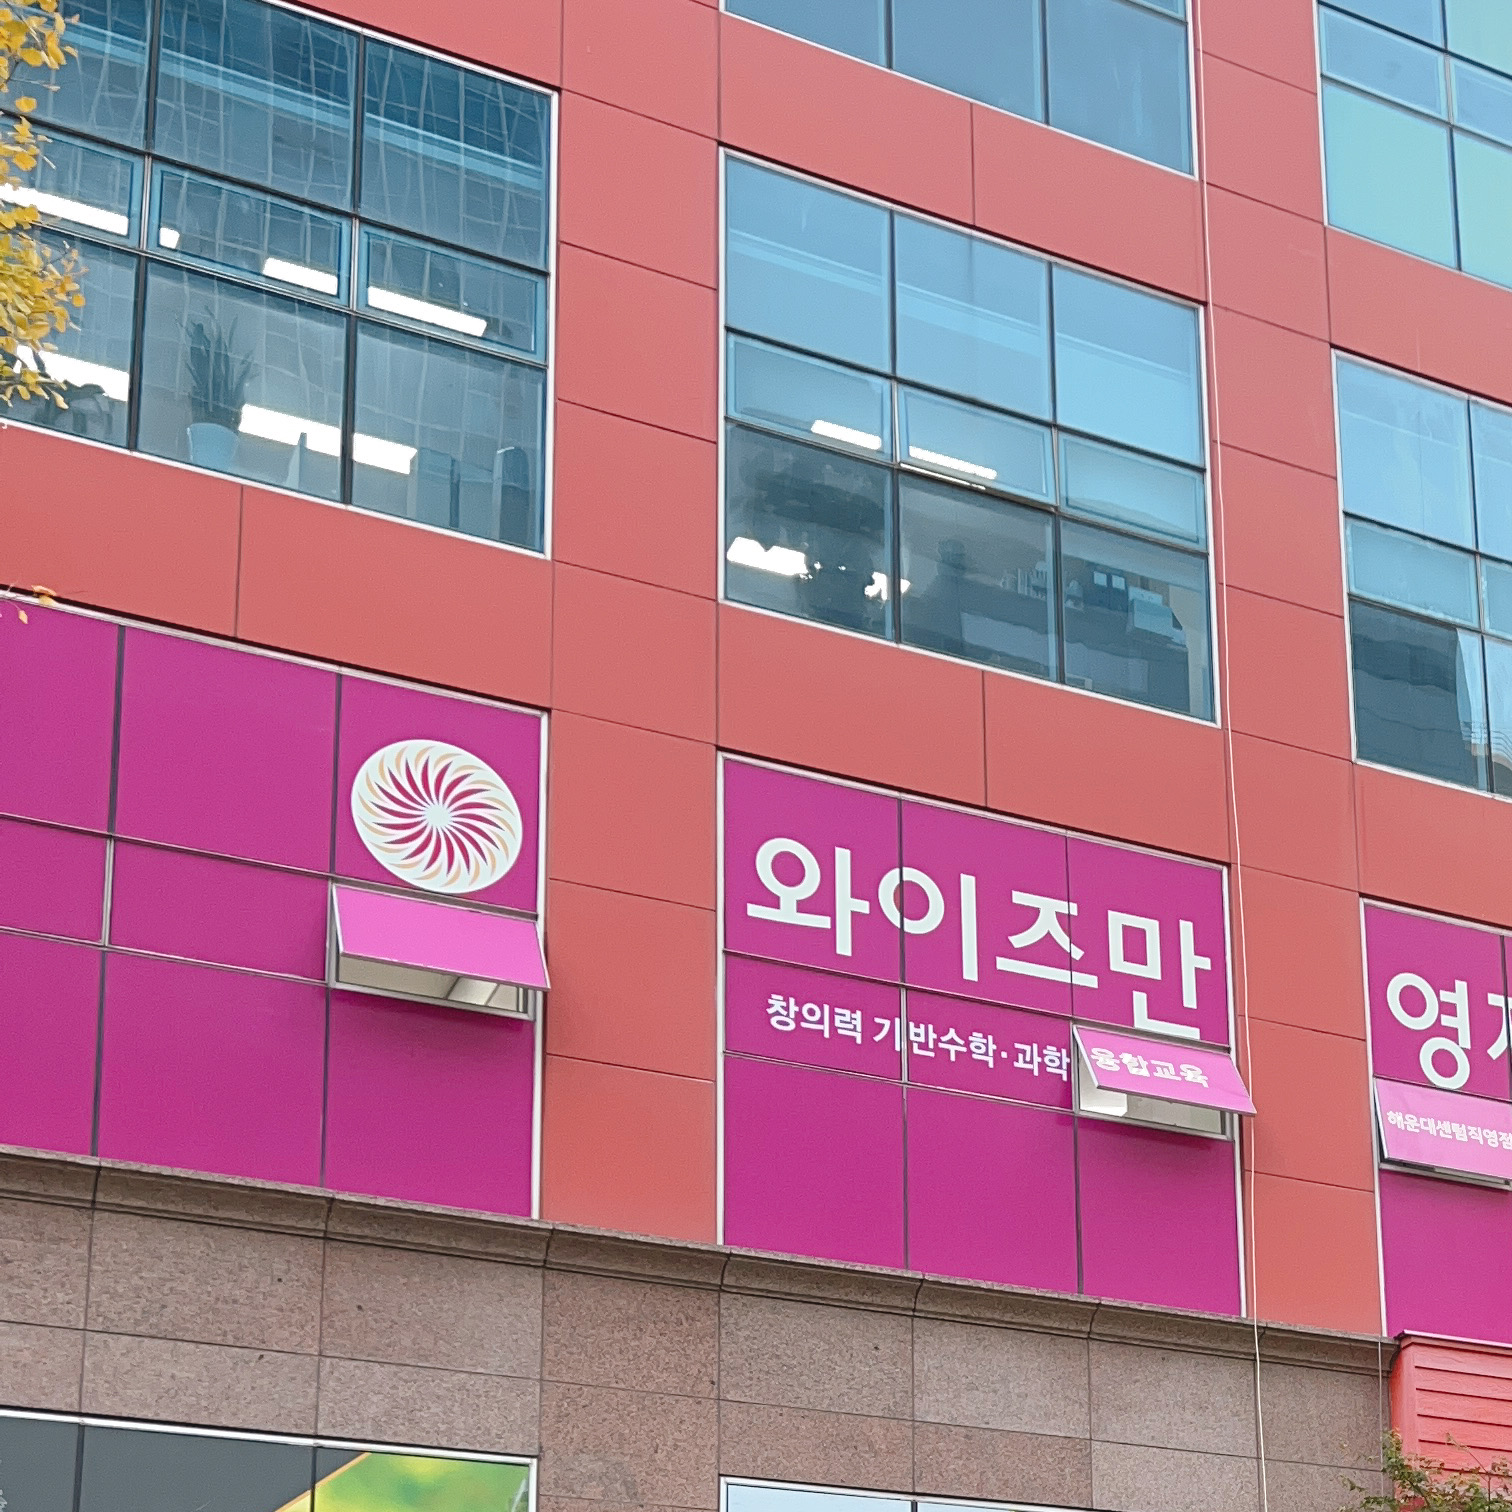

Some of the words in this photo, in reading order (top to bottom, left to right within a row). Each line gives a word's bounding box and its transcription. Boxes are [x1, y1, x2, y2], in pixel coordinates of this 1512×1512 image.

[746, 837, 1211, 1040] 와이즈만
[765, 994, 863, 1044] 창의력
[1089, 1047, 1209, 1089] 융합교육
